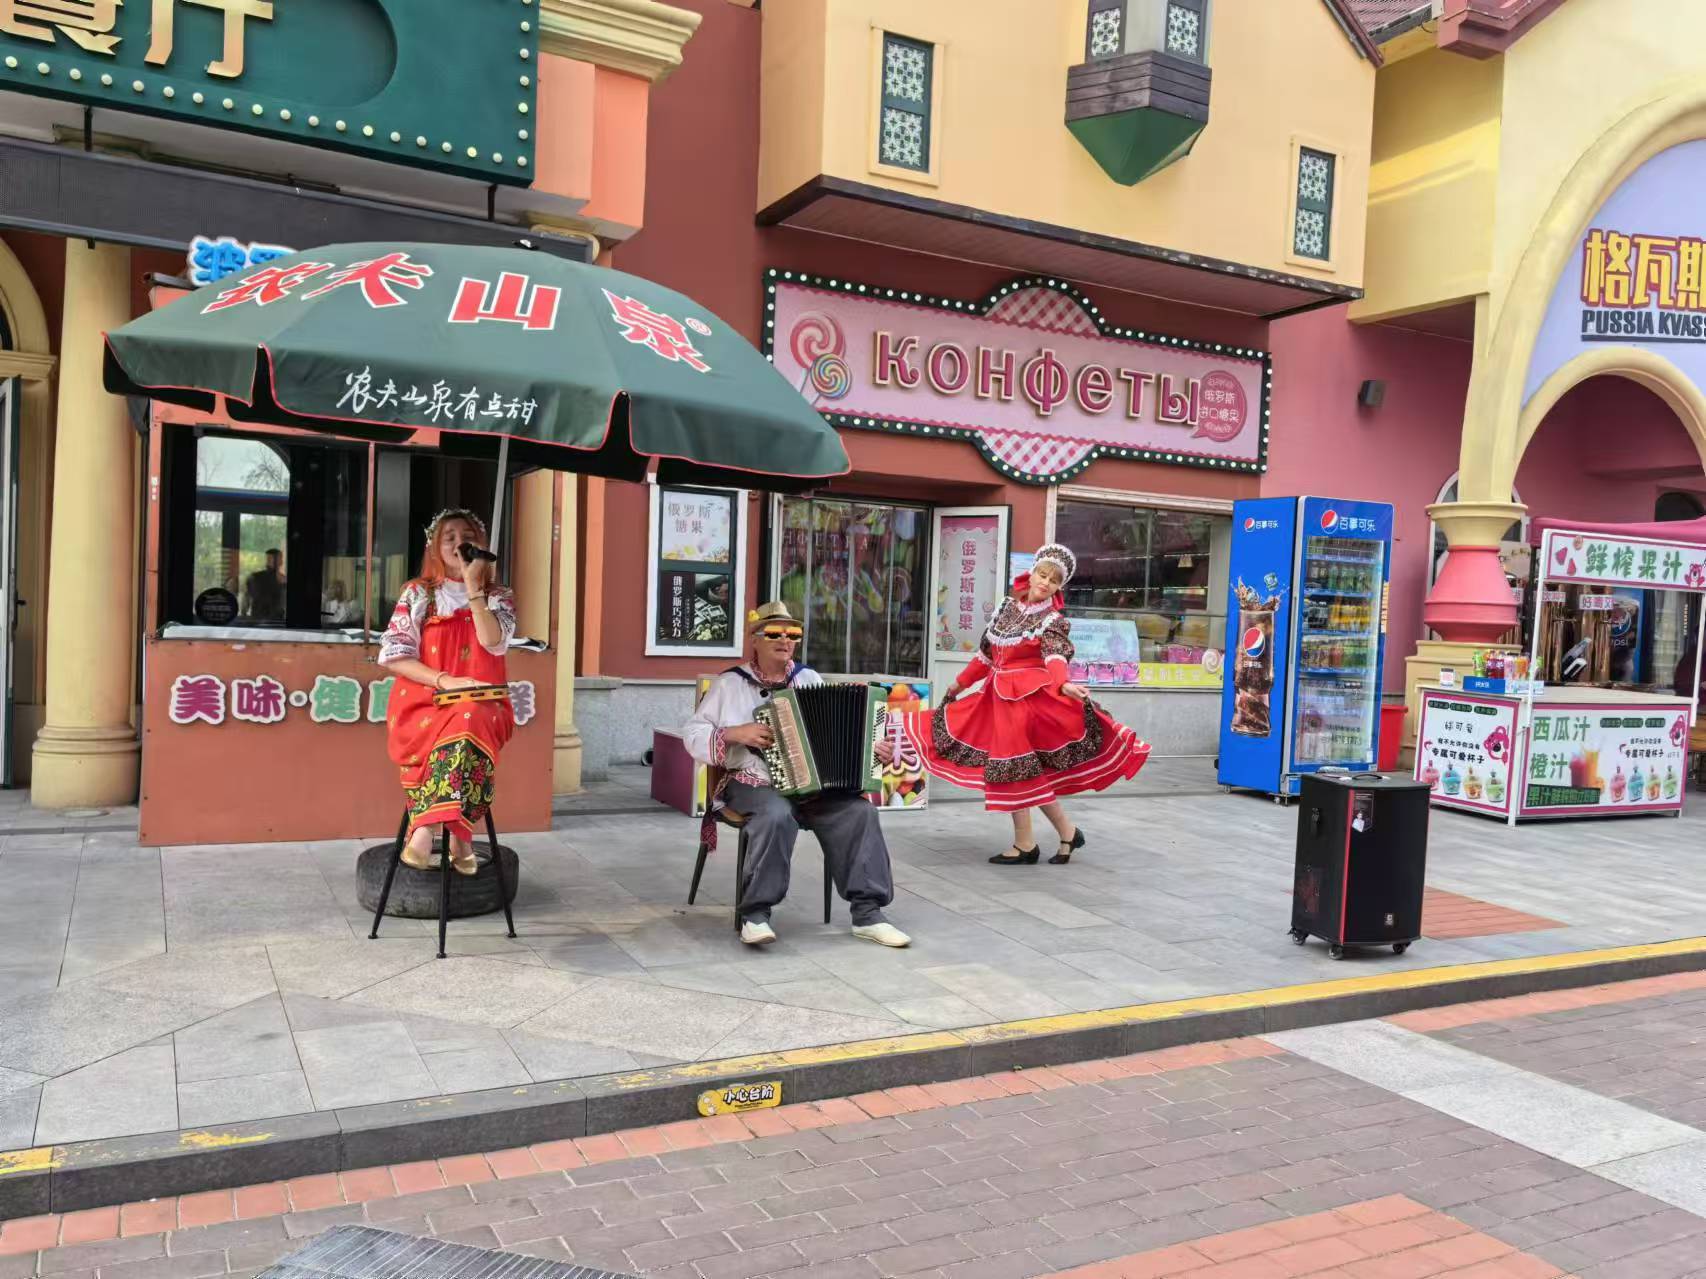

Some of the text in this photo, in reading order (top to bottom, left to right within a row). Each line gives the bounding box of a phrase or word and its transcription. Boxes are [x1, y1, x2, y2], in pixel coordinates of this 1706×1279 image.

[200, 252, 712, 373] 农夫山泉
[1658, 311, 1706, 338] KVAS
[335, 366, 538, 425] 农夫山泉有点甜
[667, 503, 712, 519] 俄罗斯
[1339, 517, 1376, 532] 百事可乐
[1584, 542, 1683, 582] 鲜榨果汁
[959, 540, 977, 631] 俄罗斯糖果
[671, 575, 683, 638] 俄罗斯巧克力
[1533, 716, 1591, 743] 西瓜汁
[1431, 747, 1485, 764] 专属可爱杯子
[1529, 752, 1569, 780] 橙汁
[722, 1084, 775, 1105] 小心台阶
